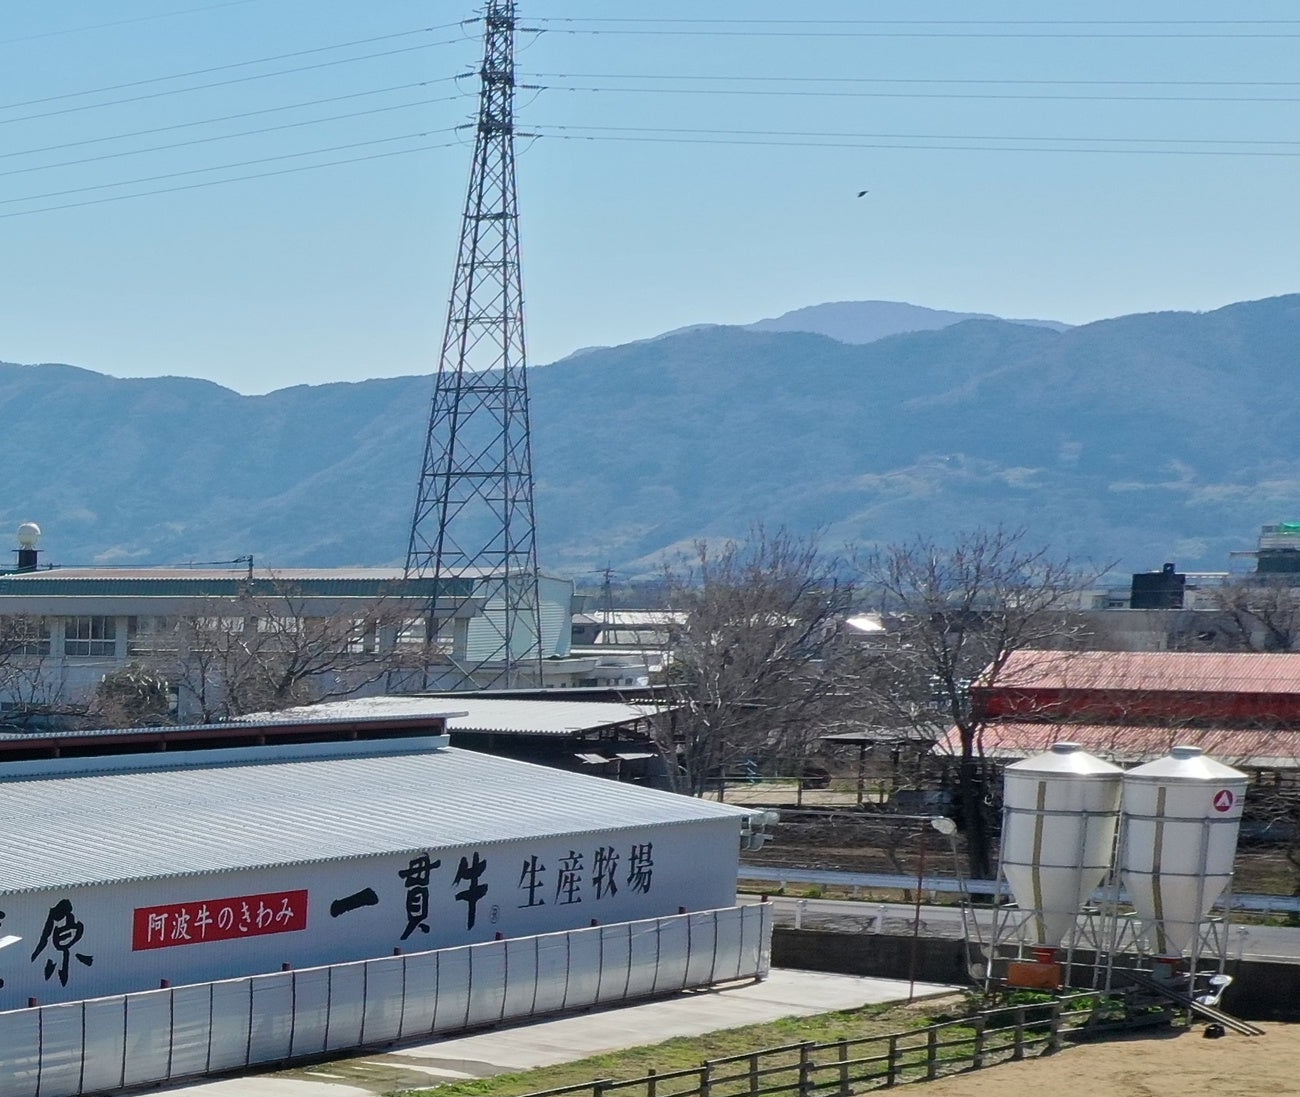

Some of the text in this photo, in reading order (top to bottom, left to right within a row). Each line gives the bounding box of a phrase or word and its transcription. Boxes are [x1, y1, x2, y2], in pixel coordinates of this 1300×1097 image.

[147, 897, 295, 943] 阿波牛のきわみ
[330, 842, 654, 941] 一貫牛 生産牧場
